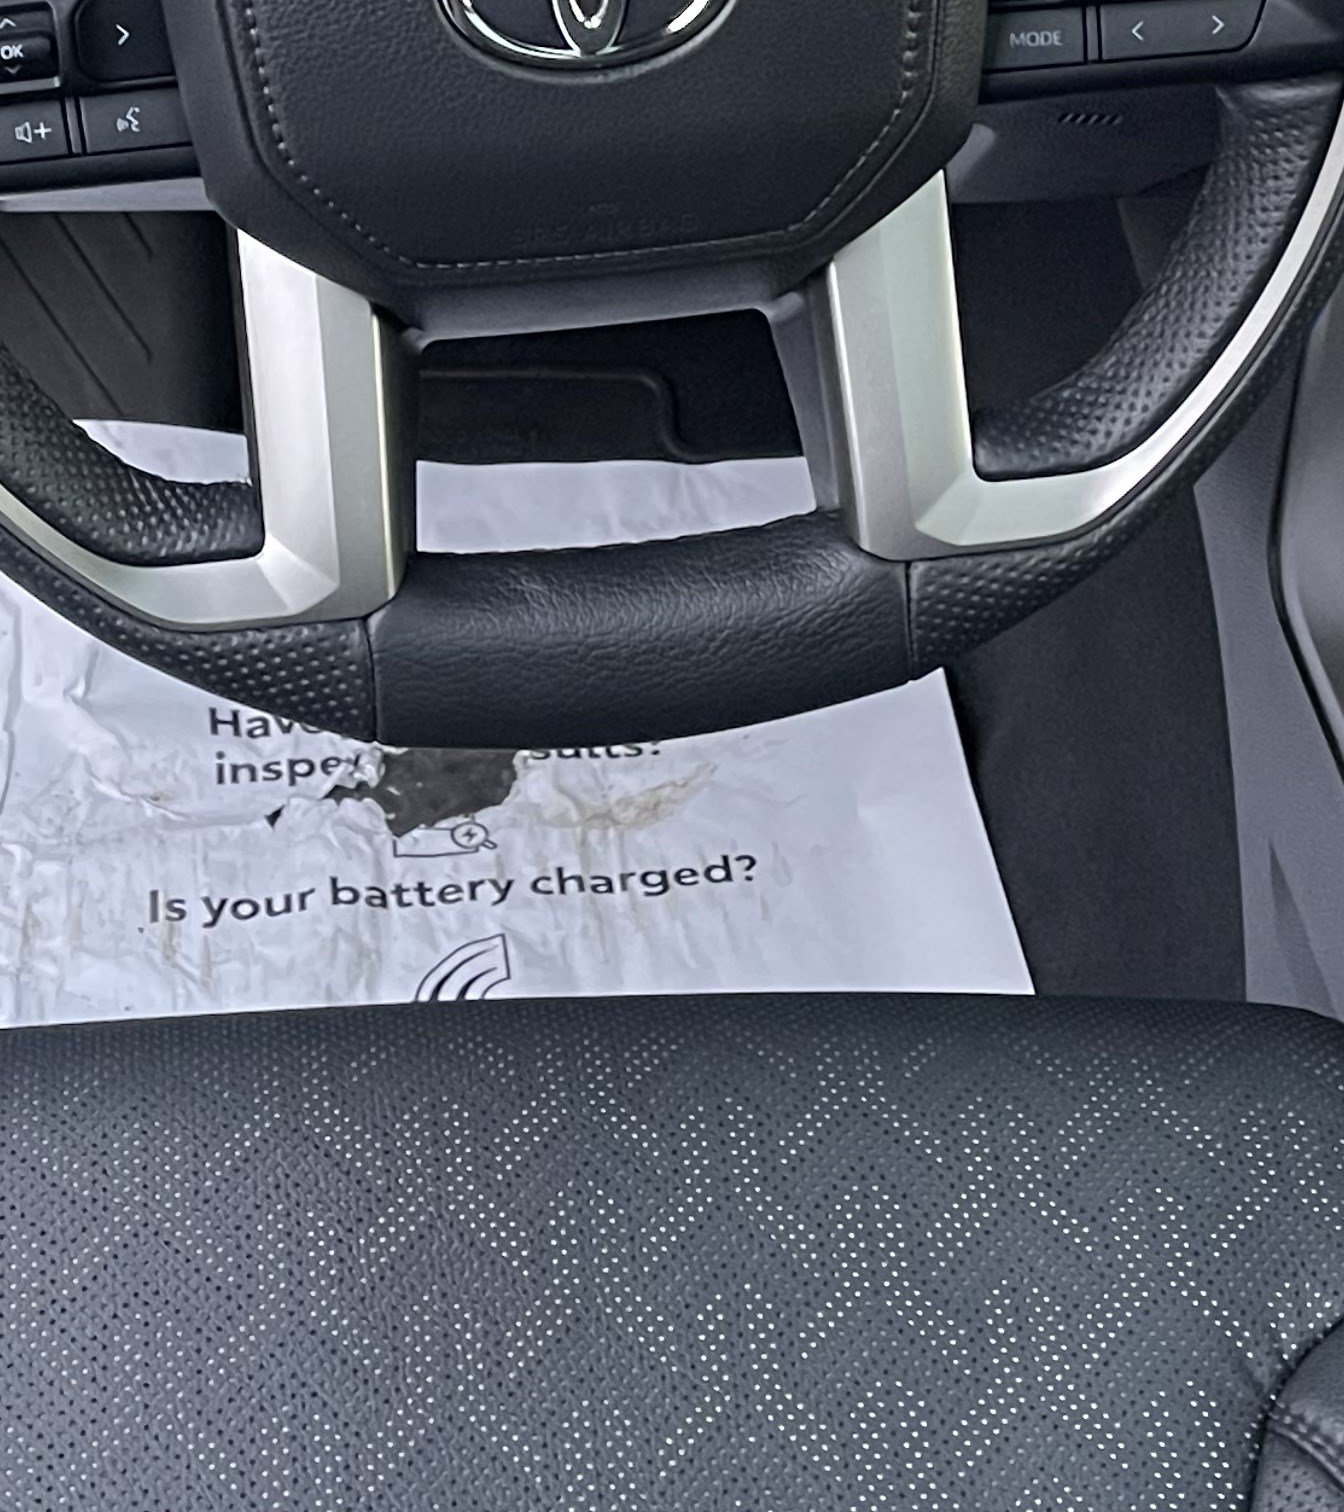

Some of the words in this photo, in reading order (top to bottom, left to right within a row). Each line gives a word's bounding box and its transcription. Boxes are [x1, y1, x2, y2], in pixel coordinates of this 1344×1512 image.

[1010, 31, 1062, 46] MODE
[0, 44, 23, 59] OK
[215, 751, 362, 787] inspe
[150, 890, 186, 923] Is
[202, 888, 315, 928] your
[330, 877, 514, 909] battery
[531, 855, 756, 896] charged?
